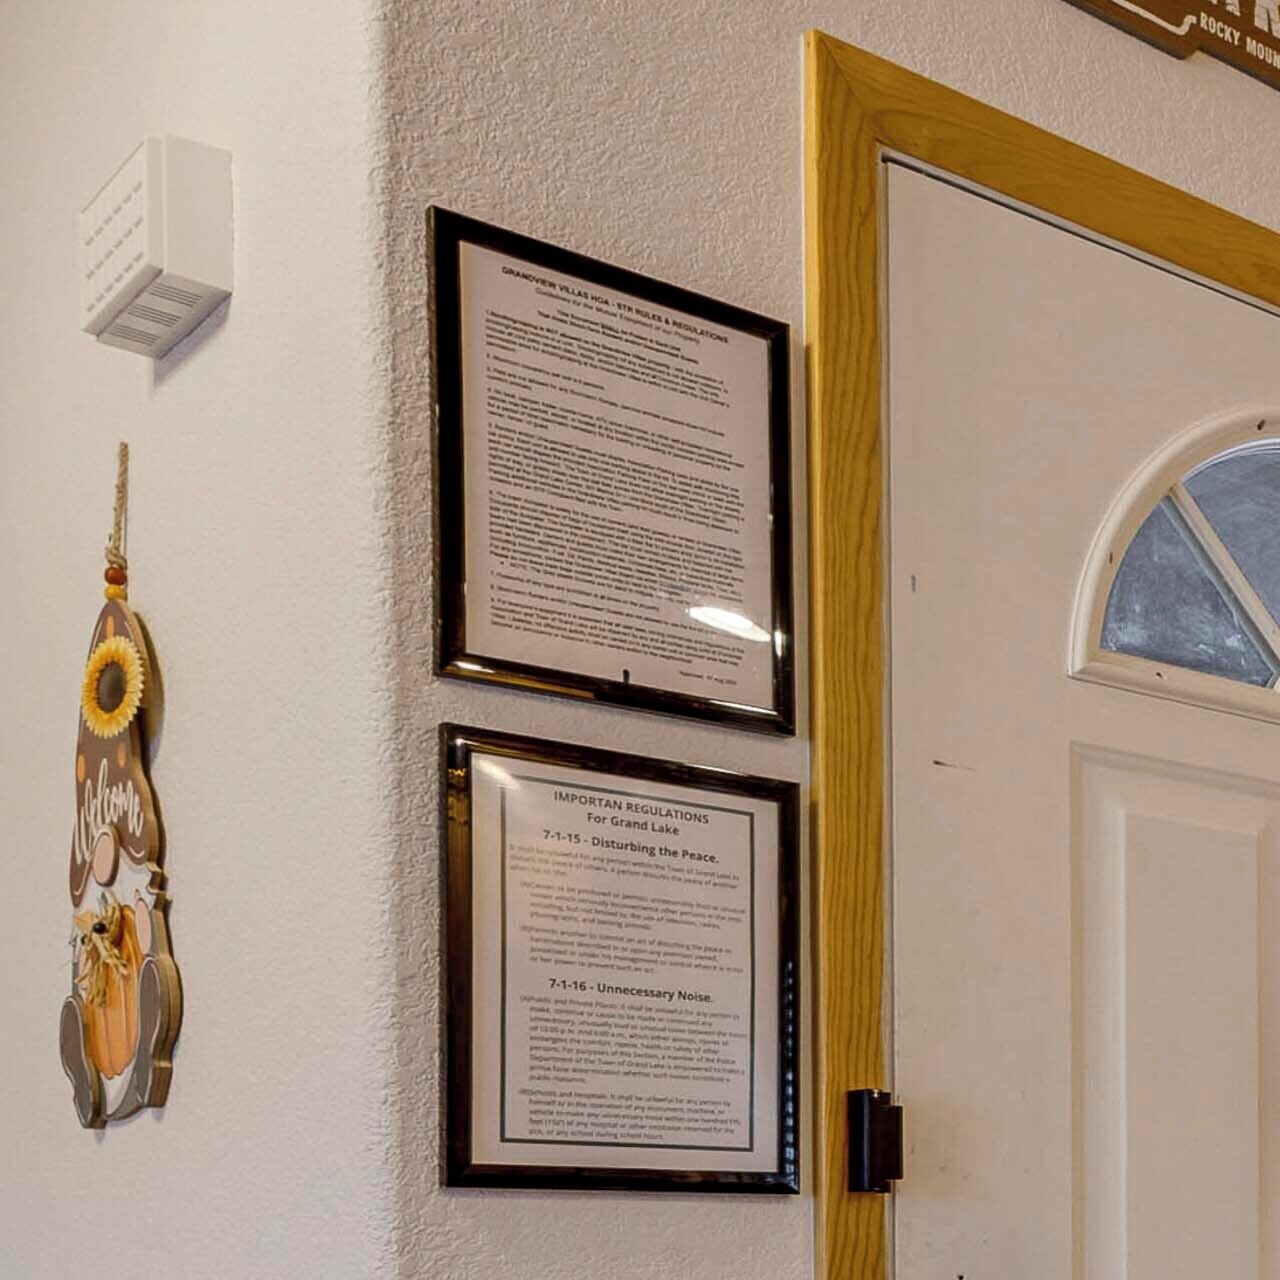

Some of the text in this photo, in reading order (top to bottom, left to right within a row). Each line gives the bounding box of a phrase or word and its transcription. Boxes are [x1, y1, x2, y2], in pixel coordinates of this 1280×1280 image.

[1200, 12, 1241, 46] ROCKY
[672, 320, 729, 343] REGULATIONS
[75, 758, 144, 865] Welcome
[554, 791, 710, 825] IMPORTAN REGULATIONS
[587, 813, 680, 836] For Grand Lake
[543, 829, 581, 844] 7-1-15
[591, 836, 656, 858] Disturbing
[659, 845, 679, 858] the
[682, 849, 720, 864] Peace.
[549, 978, 587, 992] 7-1-16
[597, 983, 675, 1001] Unnecessary
